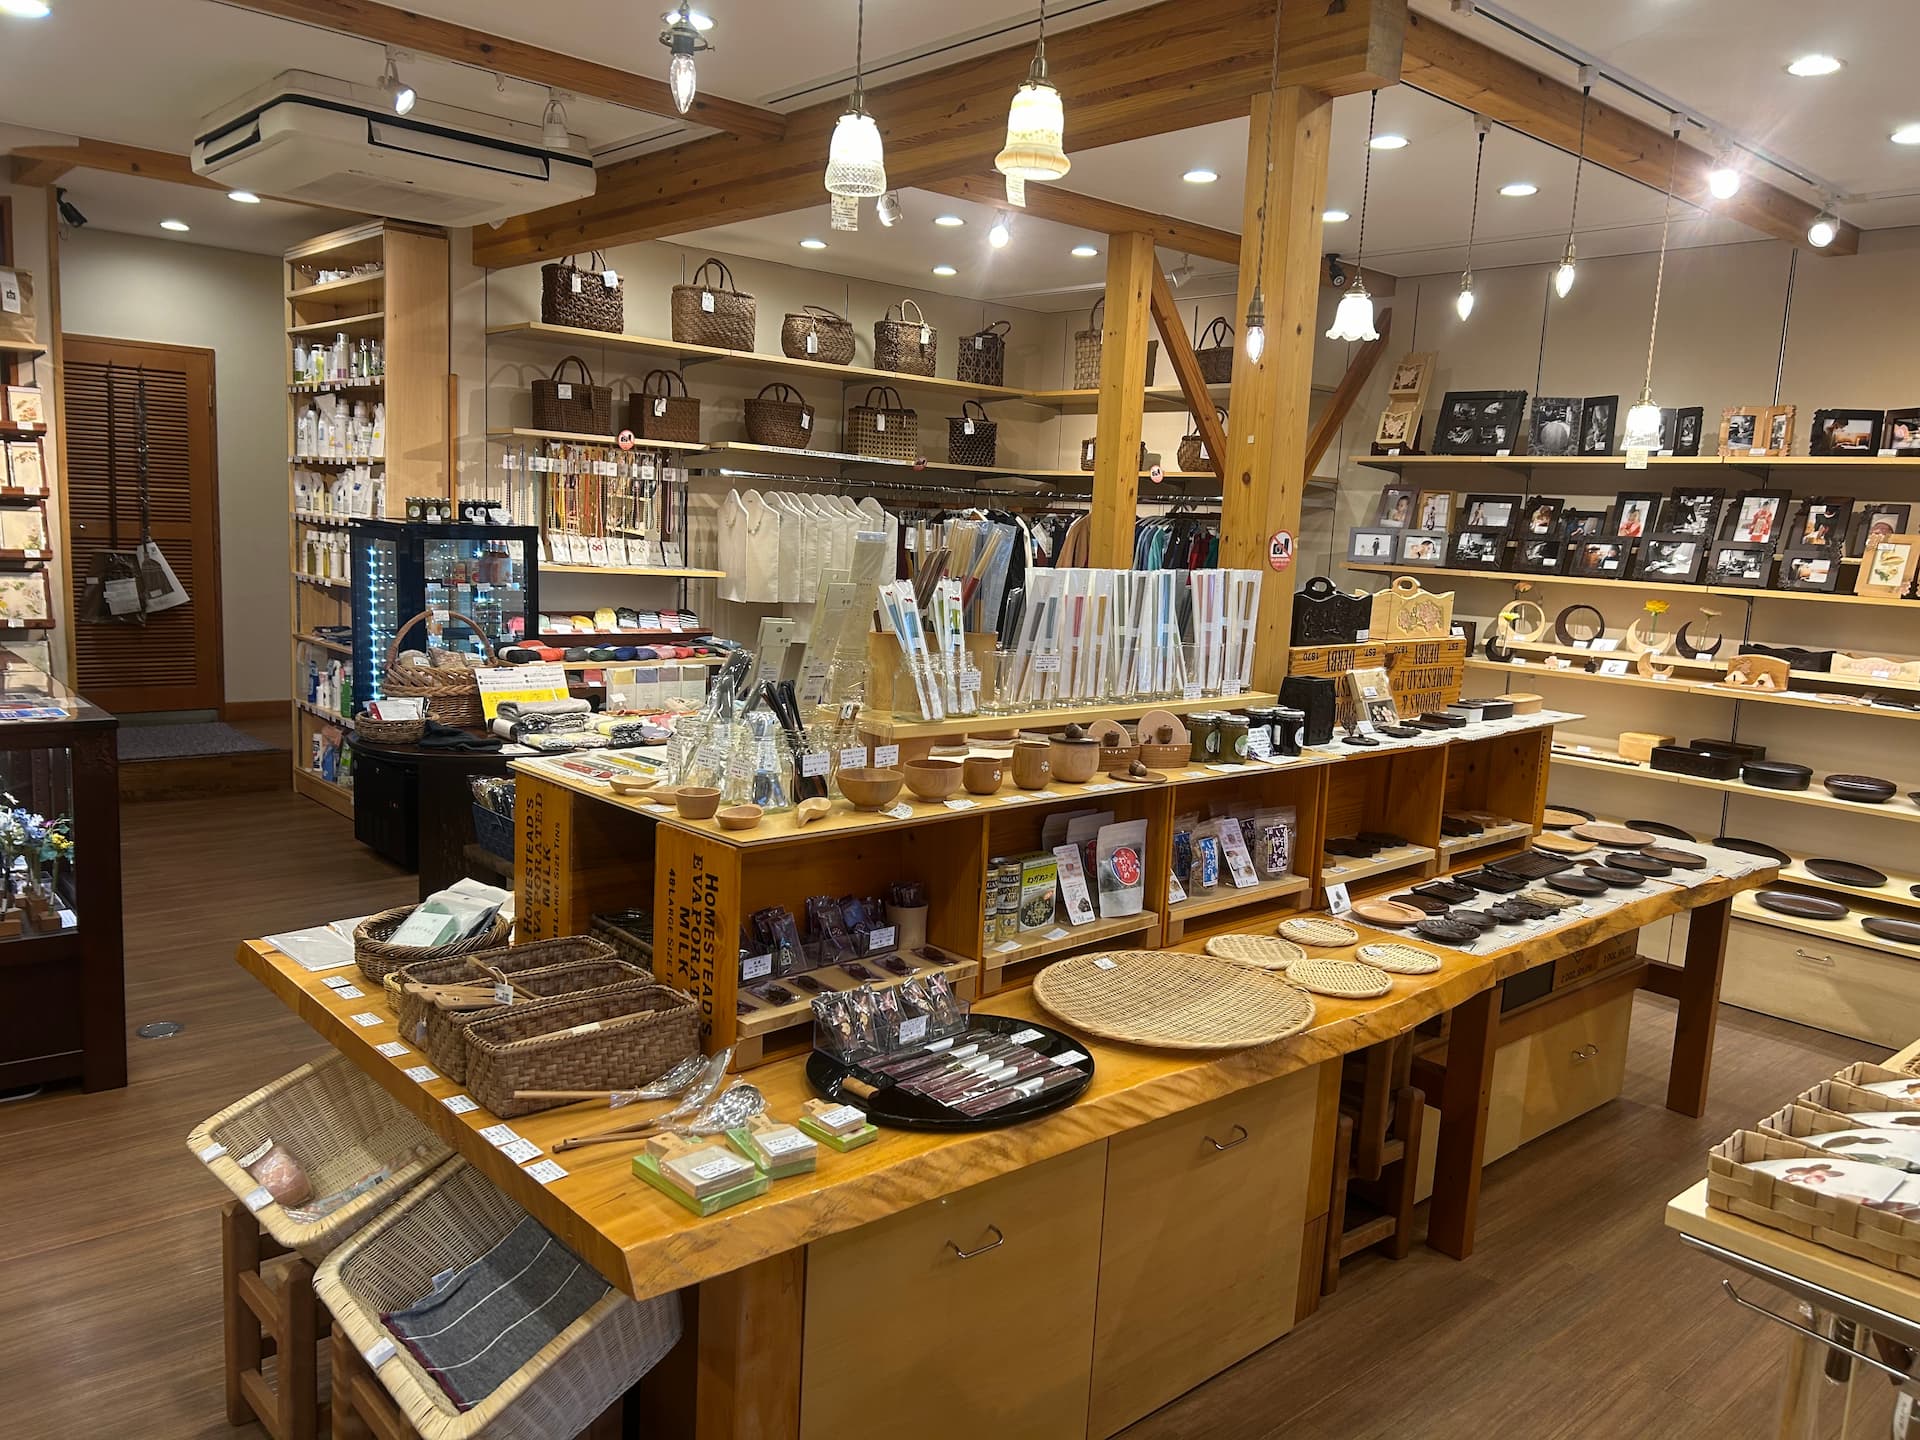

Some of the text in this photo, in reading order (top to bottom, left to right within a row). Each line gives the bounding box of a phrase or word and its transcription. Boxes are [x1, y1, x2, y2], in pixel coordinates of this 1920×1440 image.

[1302, 651, 1320, 662] 1870
[1325, 649, 1356, 673] DERBY
[1413, 643, 1441, 665] DERBY
[1406, 667, 1454, 690] HOMESTEAD
[1410, 691, 1442, 714] BROOKS
[523, 797, 534, 935] HOMESTEAD'S
[543, 847, 551, 908] MILK
[678, 905, 690, 976] MILK
[702, 872, 719, 1037] HOMESTEAD'S
